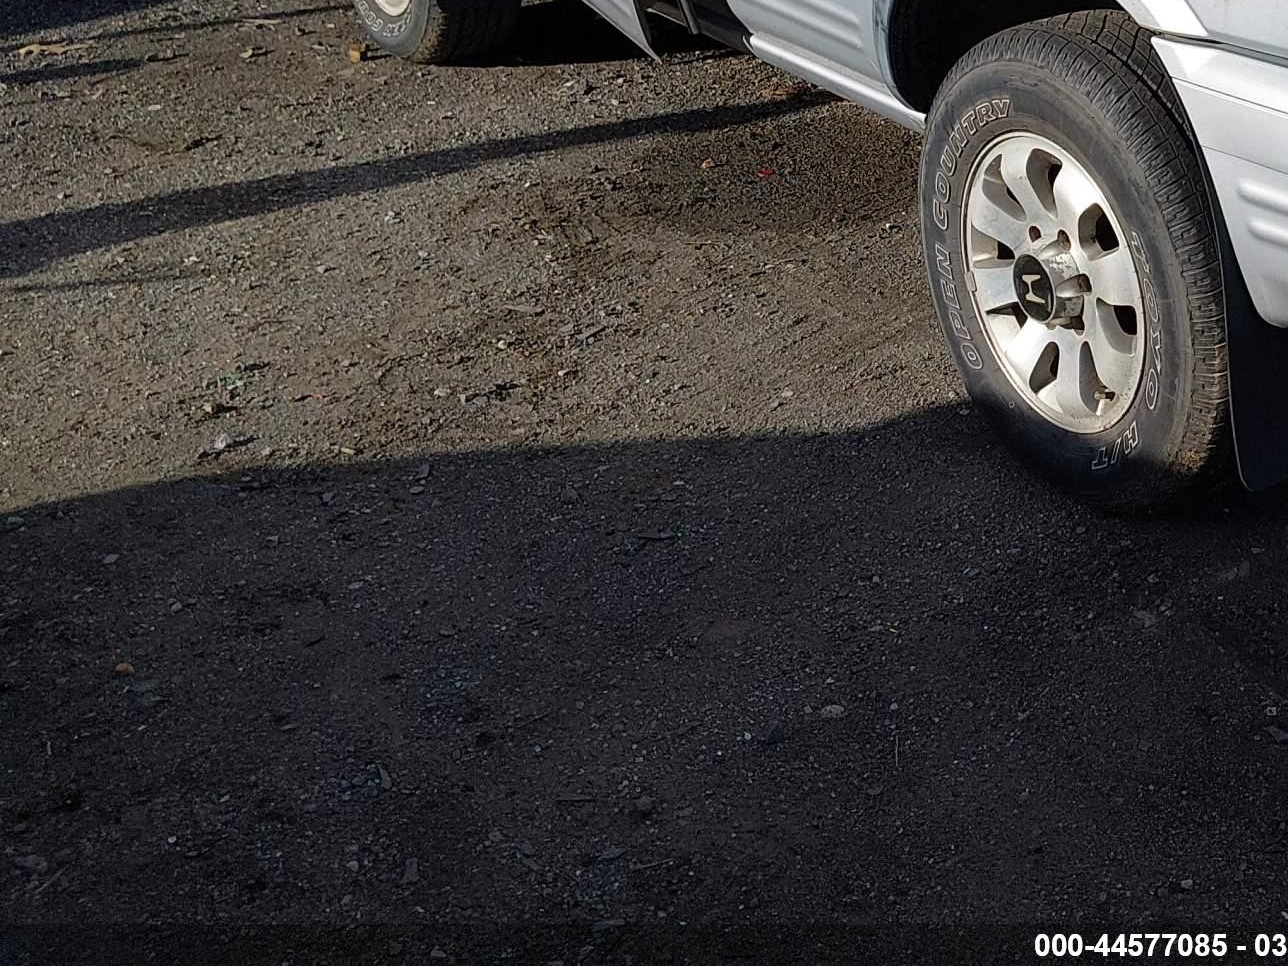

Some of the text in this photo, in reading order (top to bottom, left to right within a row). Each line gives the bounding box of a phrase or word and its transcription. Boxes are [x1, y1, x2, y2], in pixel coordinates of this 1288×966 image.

[933, 99, 1011, 370] OPEN COUNTRY
[1131, 231, 1162, 411] TOYO
[1091, 420, 1139, 470] H/T
